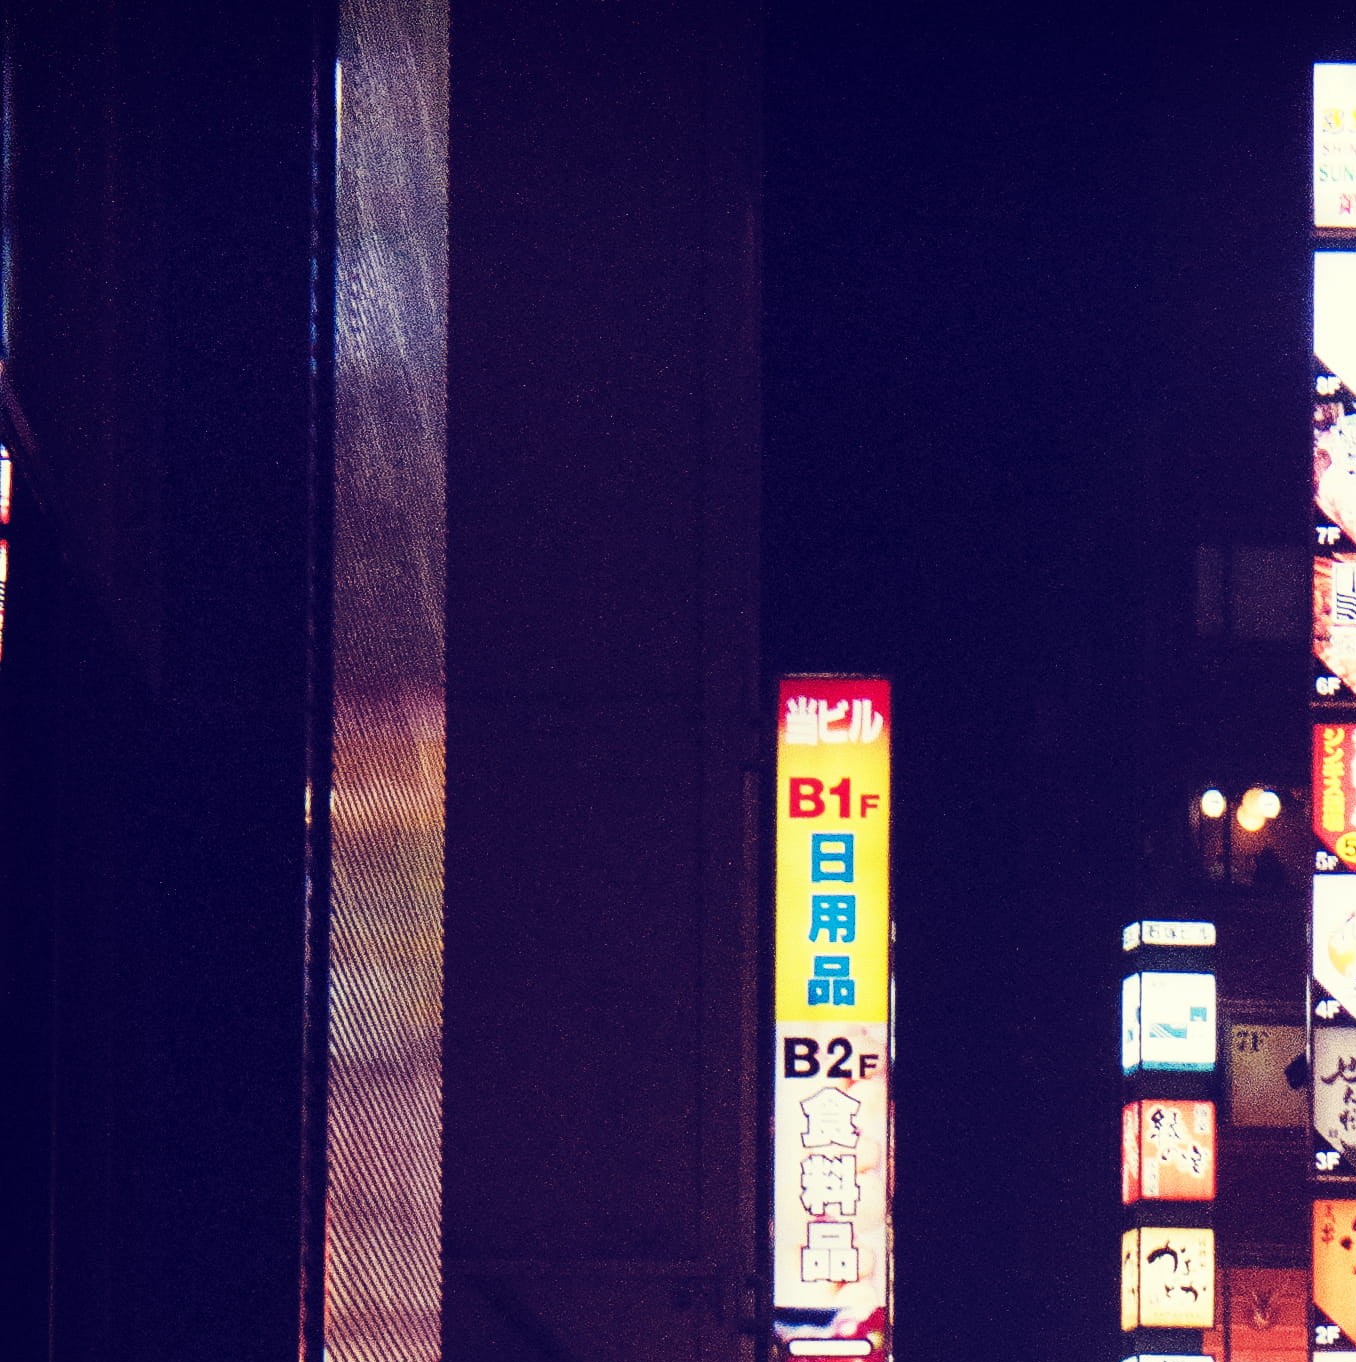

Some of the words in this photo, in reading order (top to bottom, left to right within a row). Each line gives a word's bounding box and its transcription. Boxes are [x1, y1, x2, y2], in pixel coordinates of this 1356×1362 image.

[1315, 526, 1341, 546] 7F
[1315, 675, 1342, 696] 6F
[783, 695, 884, 746] 当ビル
[788, 776, 880, 819] B1F
[807, 832, 857, 1007] 日用品
[783, 1036, 880, 1080] B2F
[799, 1086, 861, 1283] 食料品
[1314, 1325, 1341, 1345] 2F
